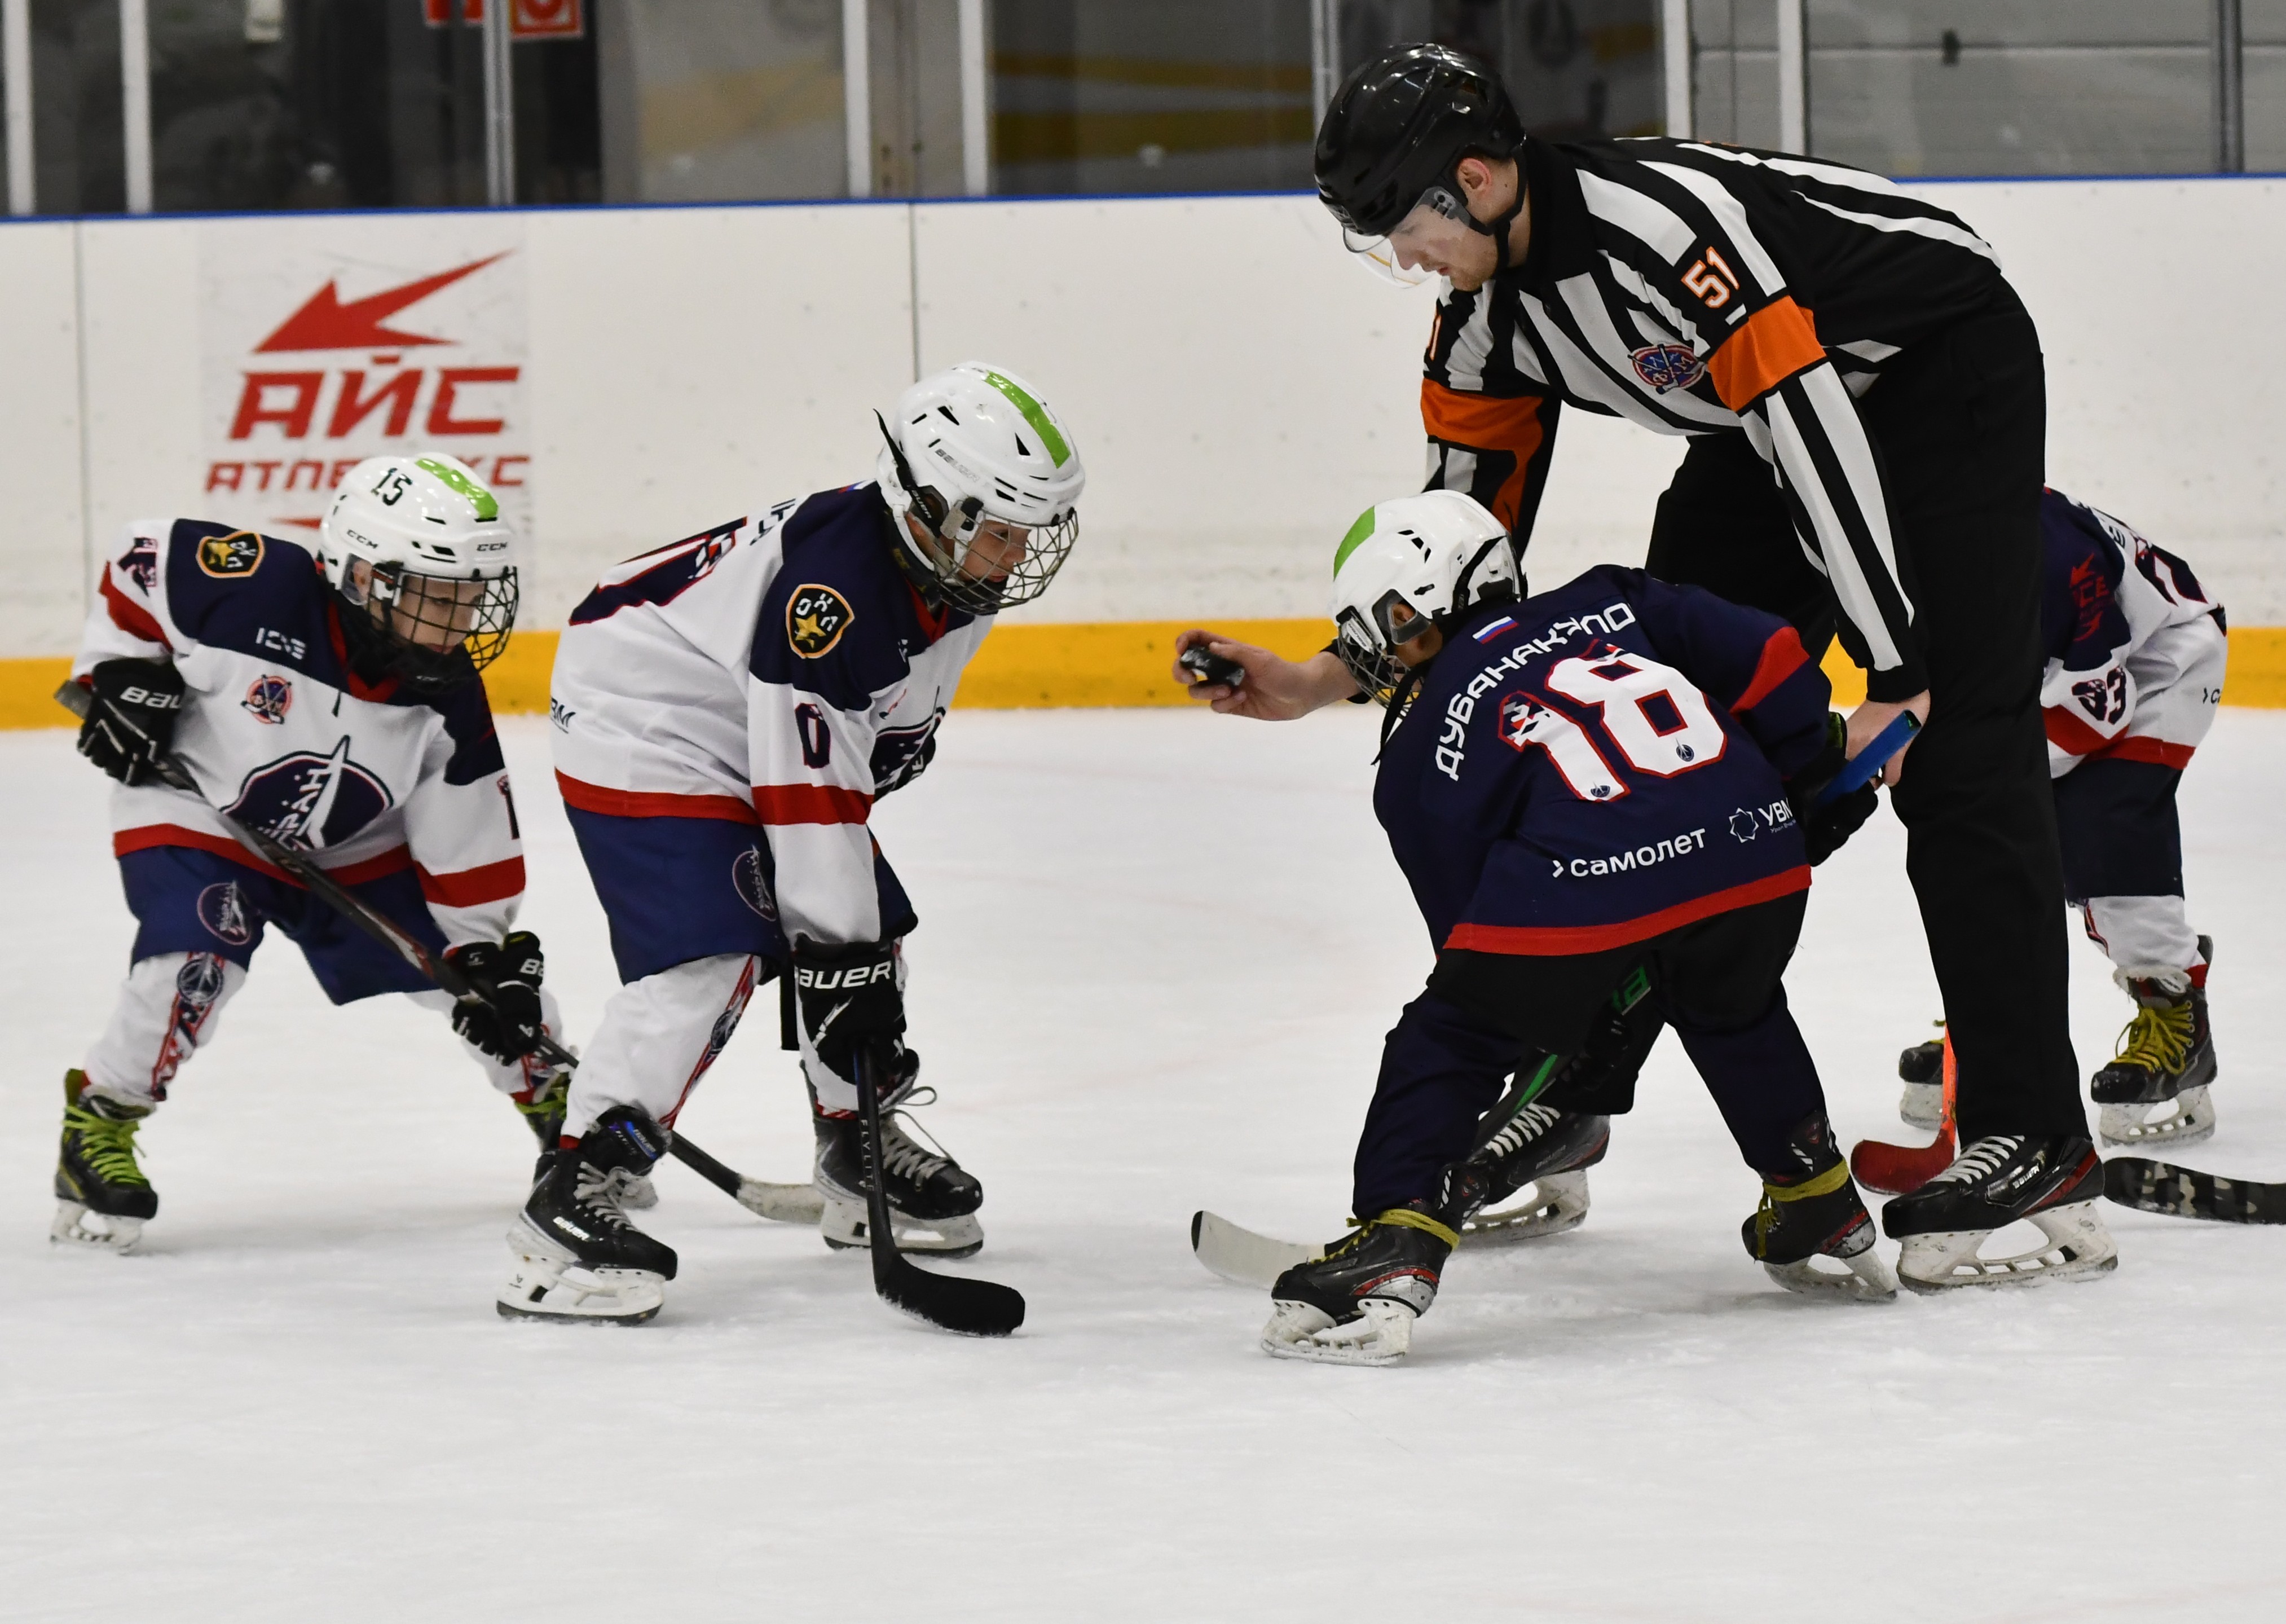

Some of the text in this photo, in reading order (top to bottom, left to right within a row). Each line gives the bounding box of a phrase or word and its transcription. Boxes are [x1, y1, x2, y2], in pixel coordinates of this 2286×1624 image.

[1681, 246, 1739, 308] 51
[228, 355, 519, 441] АЙС
[371, 468, 412, 506] 15
[346, 529, 378, 549] CCM
[477, 542, 508, 552] CCM
[1435, 602, 1636, 781] ДУБАНАКУЛО
[794, 703, 831, 769] 0
[1498, 639, 1728, 803] 18
[1570, 828, 1706, 877] самолет
[799, 960, 891, 989] AUER
[861, 1119, 874, 1192] FLYLITE
[553, 1216, 590, 1241] BAUER
